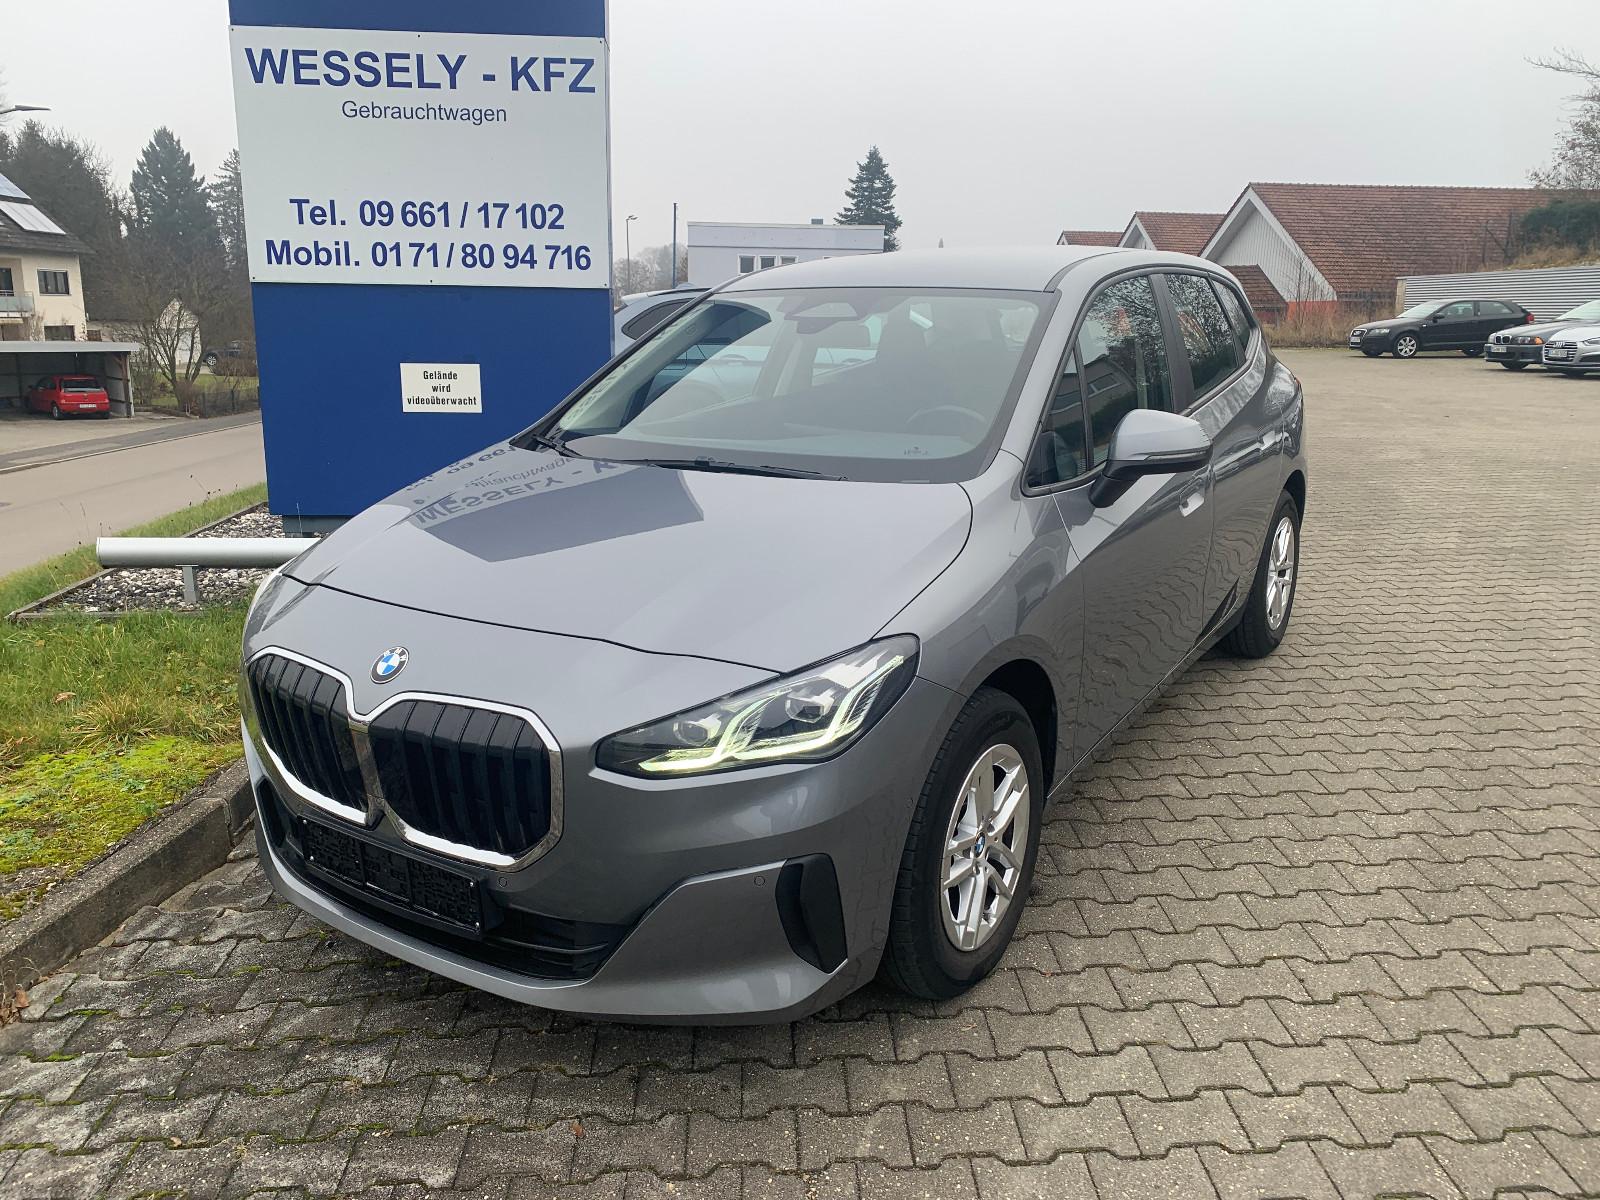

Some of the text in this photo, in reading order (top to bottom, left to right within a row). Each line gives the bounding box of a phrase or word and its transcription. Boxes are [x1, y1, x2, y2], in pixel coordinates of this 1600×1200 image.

[244, 47, 468, 90] WESSELY
[510, 55, 596, 94] KFZ
[341, 100, 507, 126] Gebrauchtwagen
[288, 198, 346, 226] Tel.
[265, 239, 360, 267] Mobil.
[544, 244, 592, 271] 716
[423, 370, 458, 380] Gelände
[431, 383, 451, 393] wird
[407, 395, 477, 406] videoüberwacht
